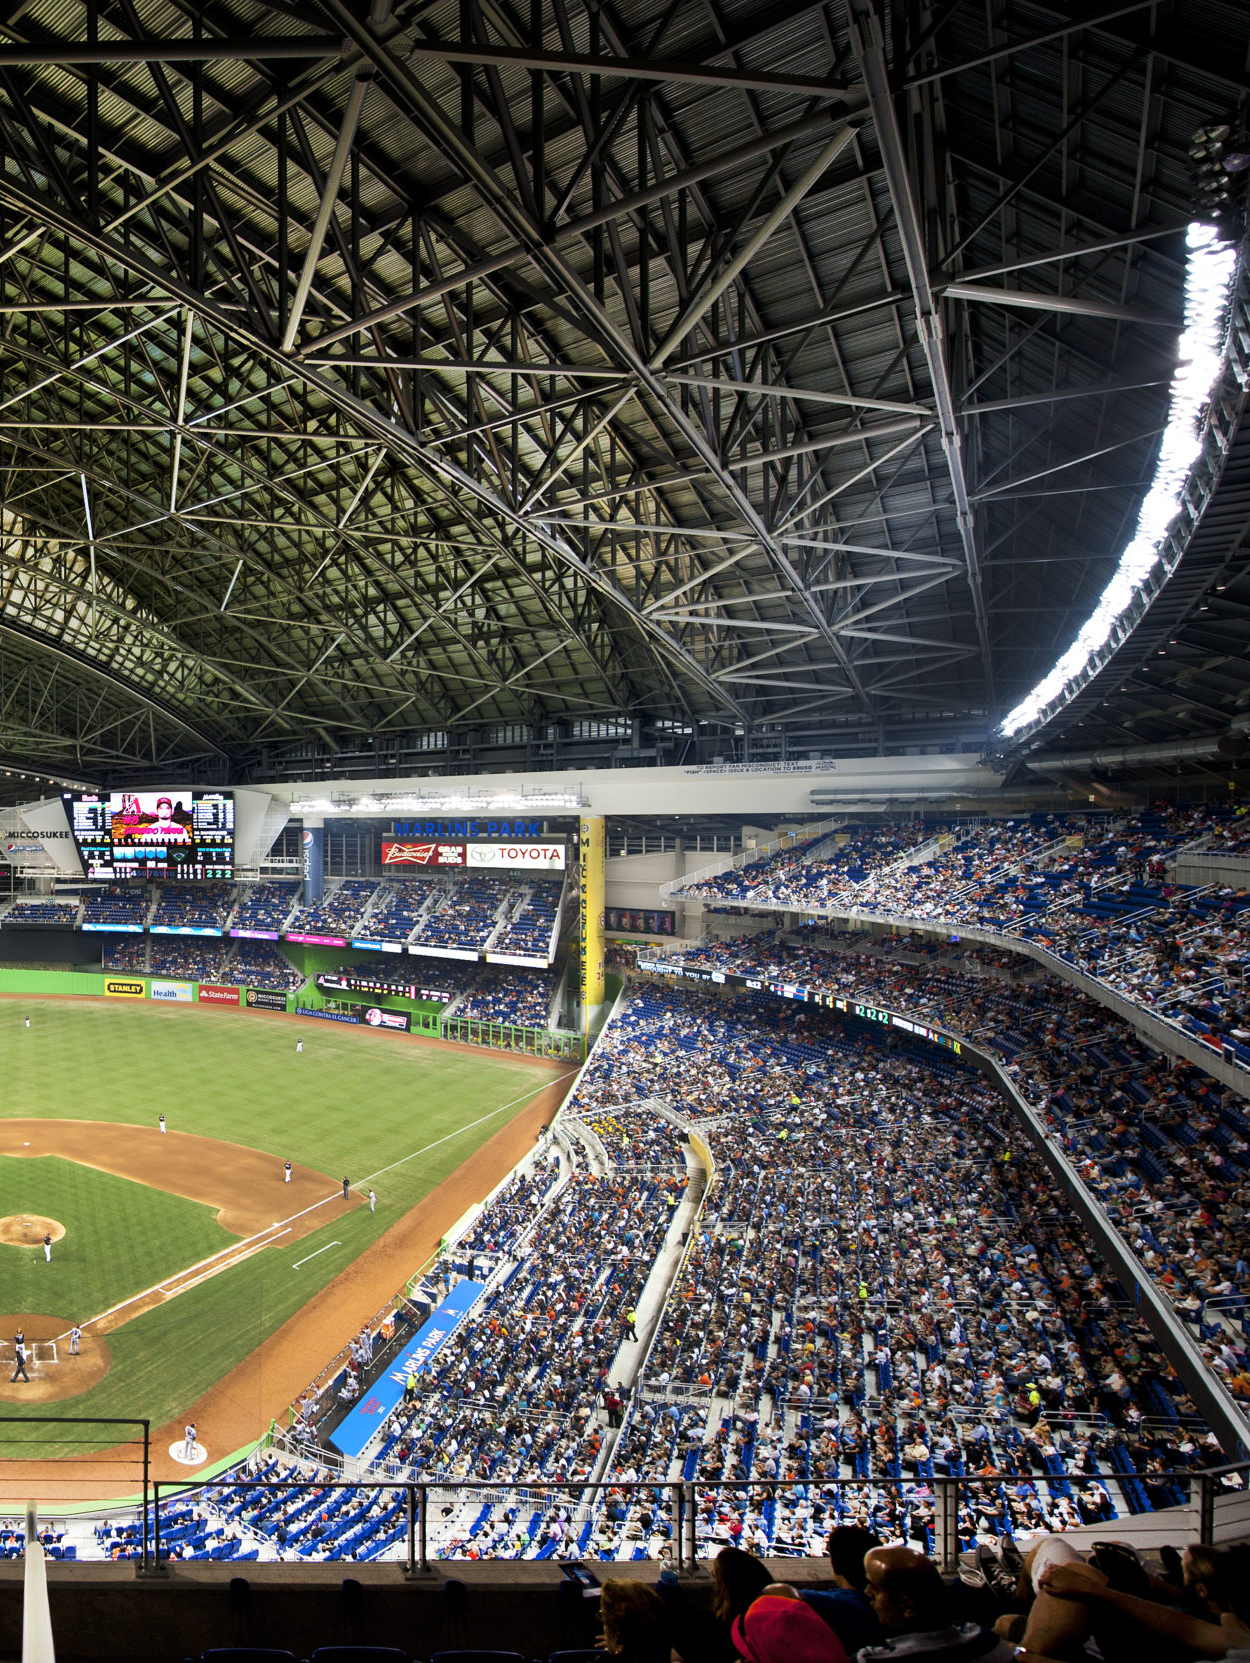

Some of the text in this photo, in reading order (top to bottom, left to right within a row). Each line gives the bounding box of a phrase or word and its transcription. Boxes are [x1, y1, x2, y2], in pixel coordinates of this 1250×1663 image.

[7, 831, 70, 839] MICCOSUKEE
[394, 822, 541, 837] MARLINS PARK
[387, 846, 433, 860] Budweiser
[498, 848, 561, 860] TOYOTA
[302, 849, 311, 881] pepsi
[206, 870, 231, 878] 2 2 2
[109, 984, 141, 993] STANLEY
[685, 971, 700, 979] YOU
[859, 1005, 866, 1017] 2
[870, 1008, 877, 1021] 2
[882, 1012, 889, 1024] 2
[312, 1011, 331, 1019] CONTRA
[337, 1015, 358, 1023] CANCER
[388, 1328, 447, 1387] MARLINS PARK
